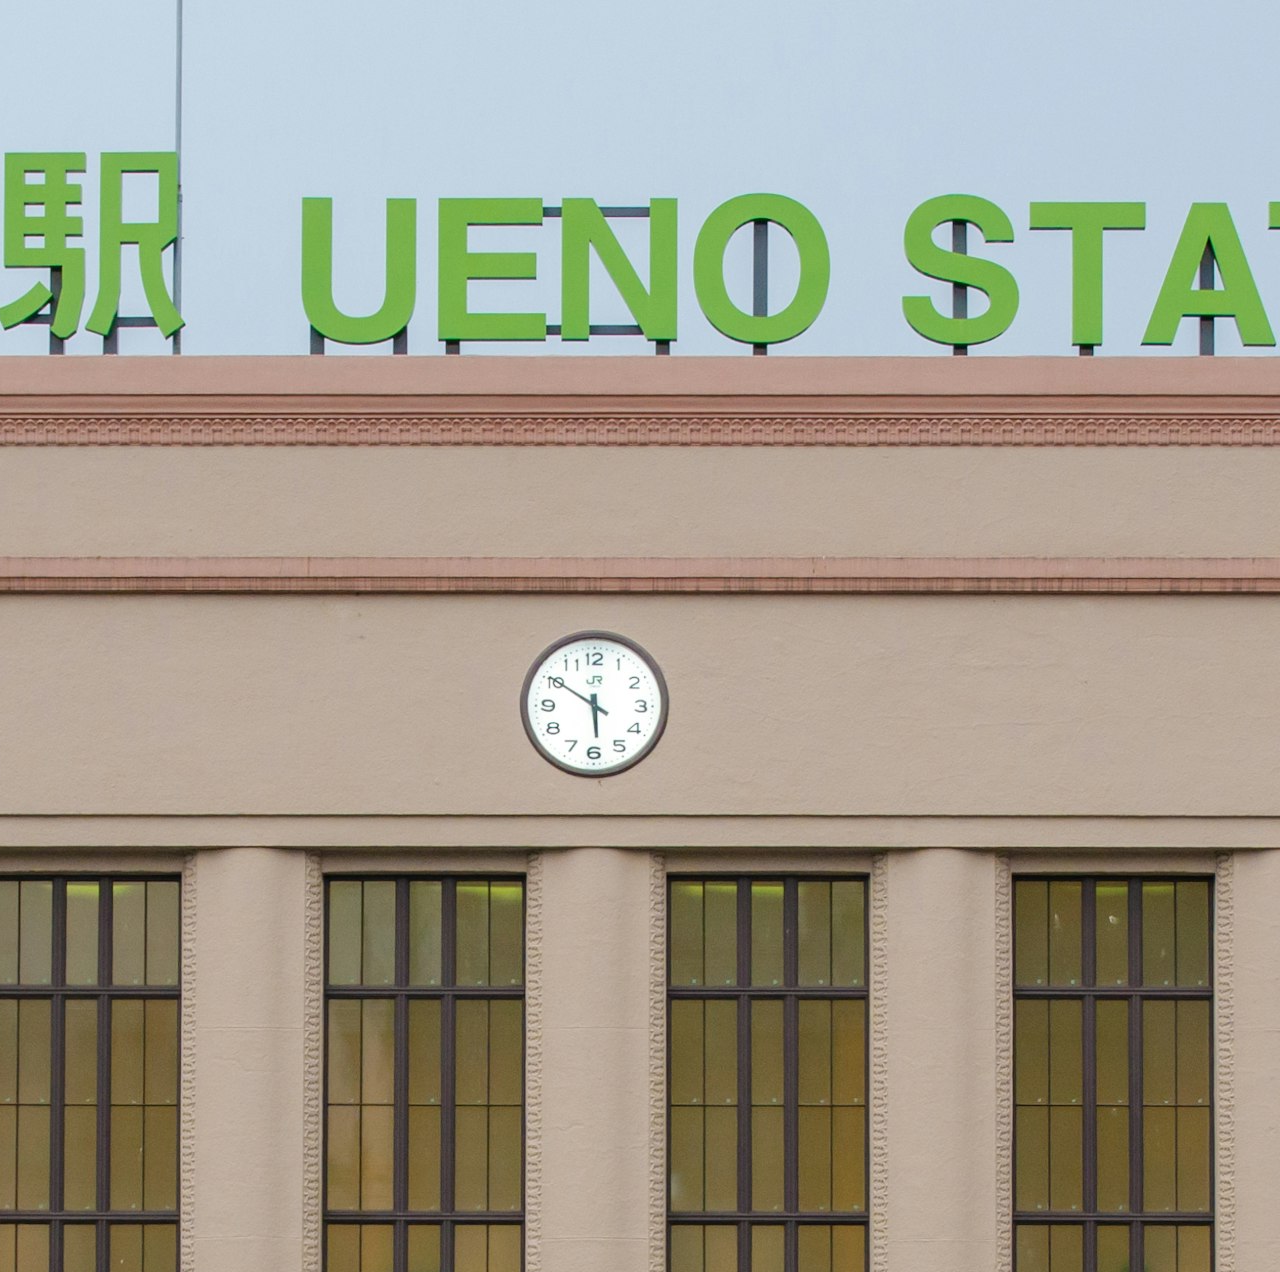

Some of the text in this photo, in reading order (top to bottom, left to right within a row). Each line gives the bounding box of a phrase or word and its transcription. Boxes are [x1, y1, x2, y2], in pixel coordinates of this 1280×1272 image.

[302, 193, 830, 345] UENO
[564, 658, 579, 672] 11
[586, 652, 604, 666] 12
[616, 658, 621, 671] 1
[547, 676, 564, 689] 10
[586, 675, 603, 685] JR
[628, 676, 640, 689] 2
[540, 699, 556, 712] 9
[634, 700, 648, 713] 3
[546, 722, 560, 735] 8
[627, 722, 641, 735] 4
[564, 740, 578, 752] 7
[613, 740, 626, 753] 5
[586, 746, 601, 760] 6
